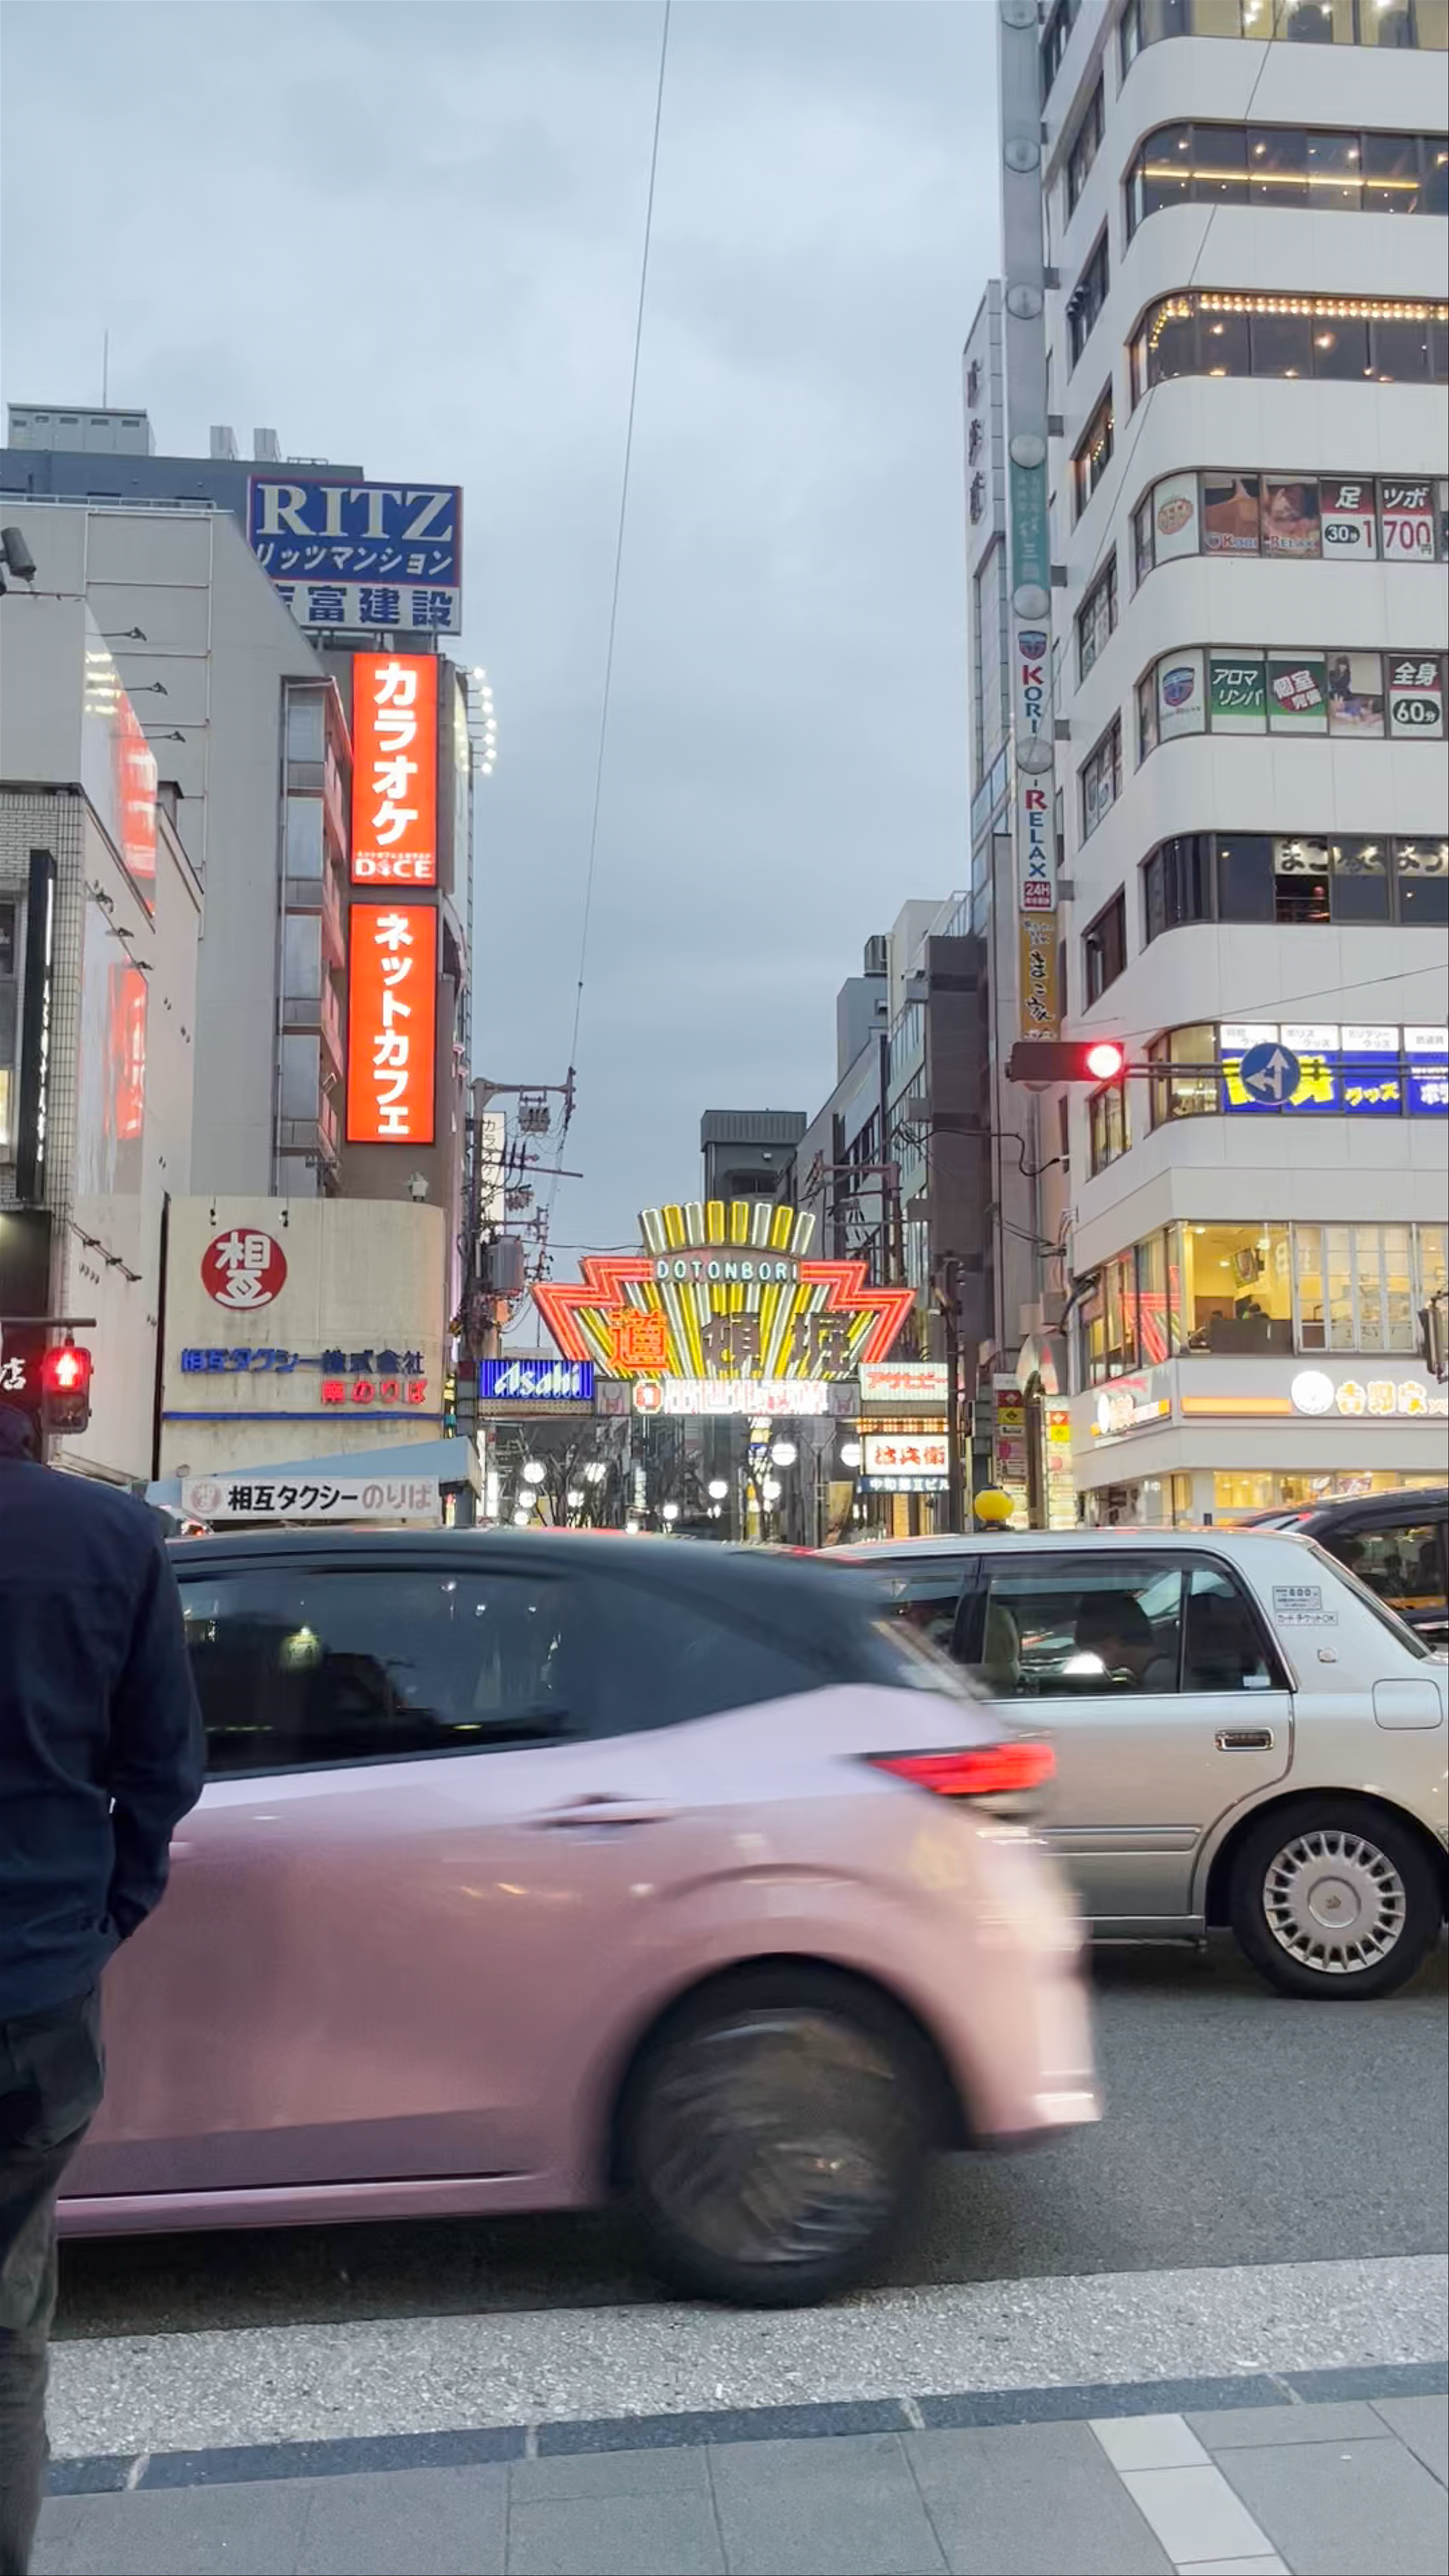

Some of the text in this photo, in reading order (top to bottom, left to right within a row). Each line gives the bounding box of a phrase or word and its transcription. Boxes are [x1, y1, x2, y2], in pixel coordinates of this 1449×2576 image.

[256, 484, 452, 542] RITZ
[256, 543, 452, 575] リッツマンション
[1213, 669, 1258, 686] アロマ
[1393, 662, 1438, 687] 全身
[372, 662, 418, 845] カラオケ
[1026, 884, 1050, 896] 24H
[373, 914, 413, 1135] ネットカフェ
[658, 1261, 797, 1280] DOTONBORI
[494, 1361, 580, 1395] Asahi
